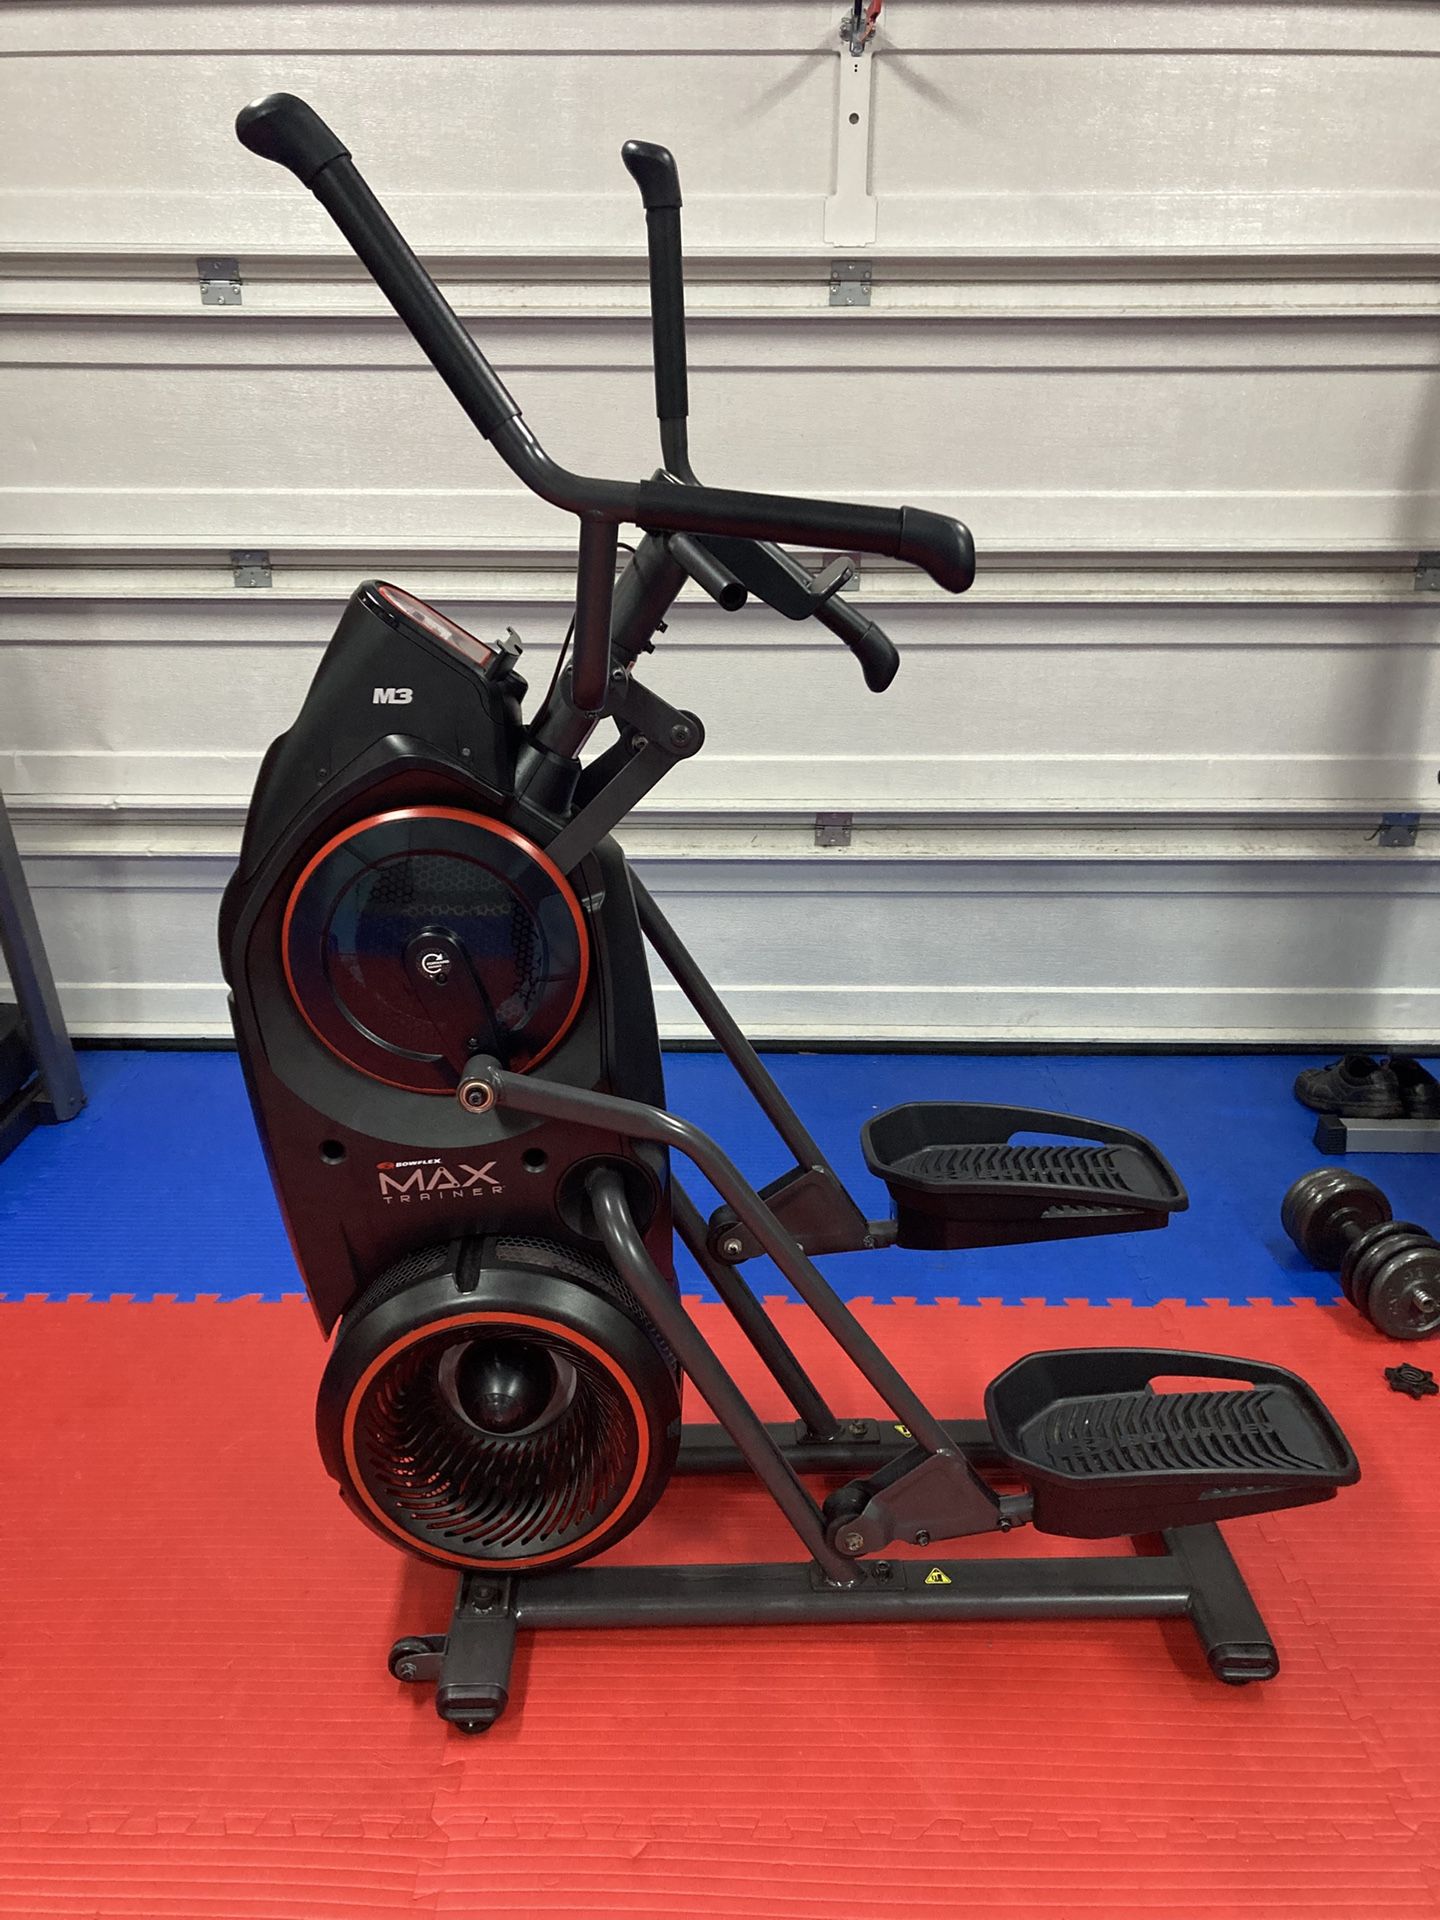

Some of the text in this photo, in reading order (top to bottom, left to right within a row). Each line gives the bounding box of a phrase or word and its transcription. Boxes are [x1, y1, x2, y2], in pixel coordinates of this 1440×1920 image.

[373, 688, 413, 704] M3
[395, 1158, 441, 1168] BOWFLEX
[378, 1161, 500, 1195] MAX
[383, 1186, 503, 1204] TRAINER
